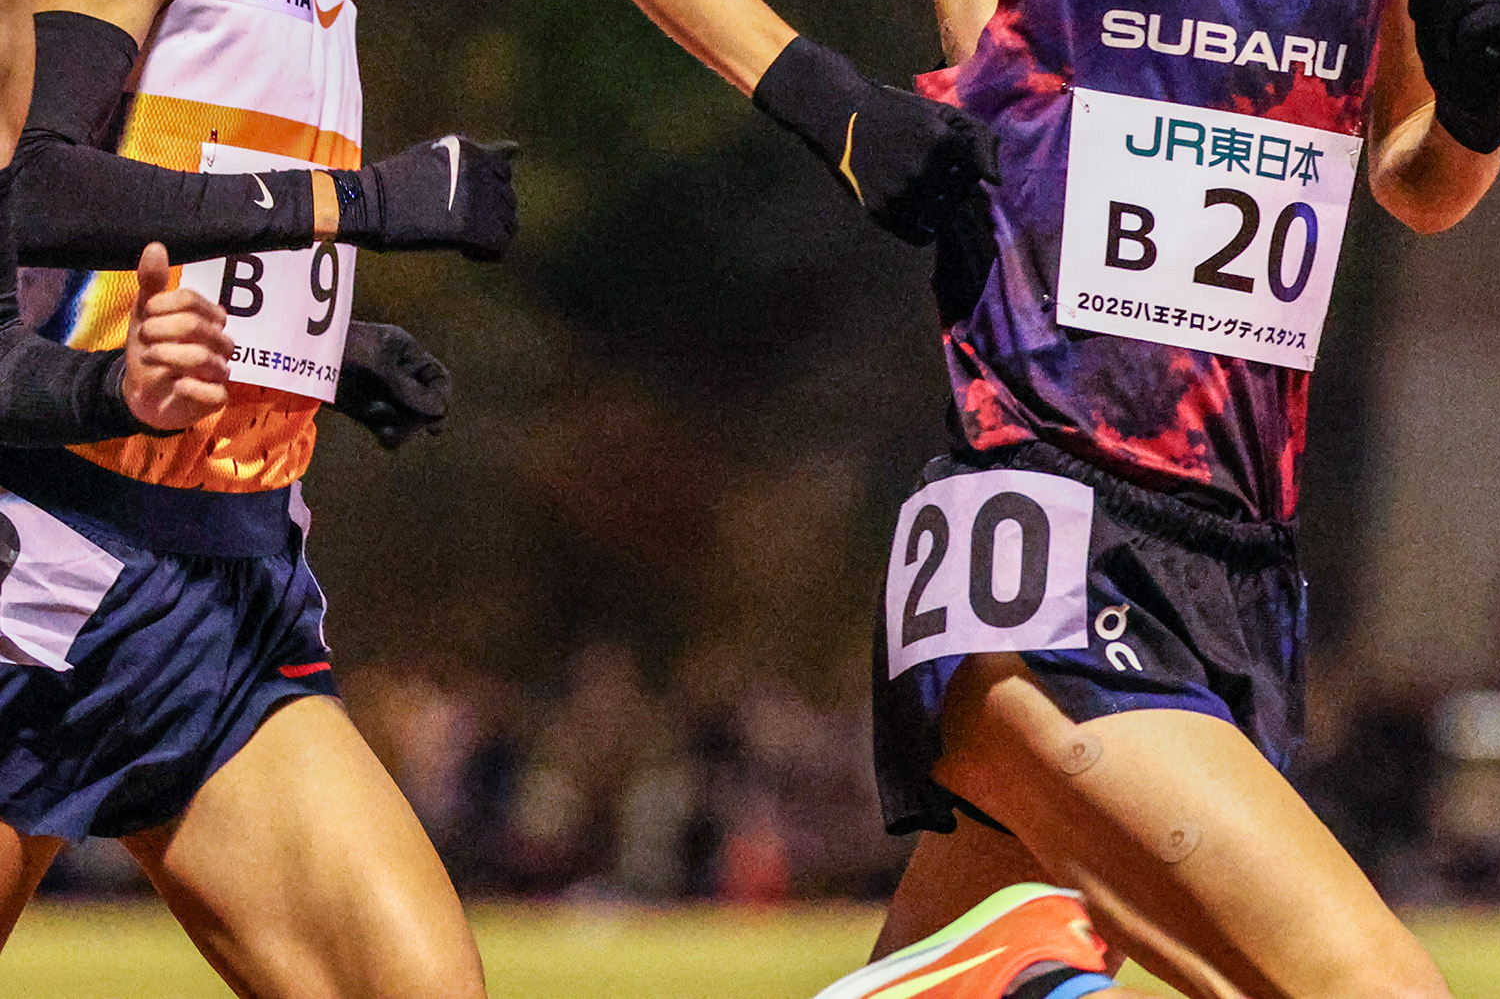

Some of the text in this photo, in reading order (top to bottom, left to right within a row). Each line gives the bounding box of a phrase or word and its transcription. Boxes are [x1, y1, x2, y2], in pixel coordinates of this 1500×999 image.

[1100, 9, 1349, 81] SUBARU
[1125, 116, 1324, 186] JR東日本
[1104, 188, 1319, 303] B 20
[219, 240, 339, 336] B 9
[1077, 292, 1306, 350] 2025八王子ロングディスタンス
[901, 491, 1051, 649] 20
